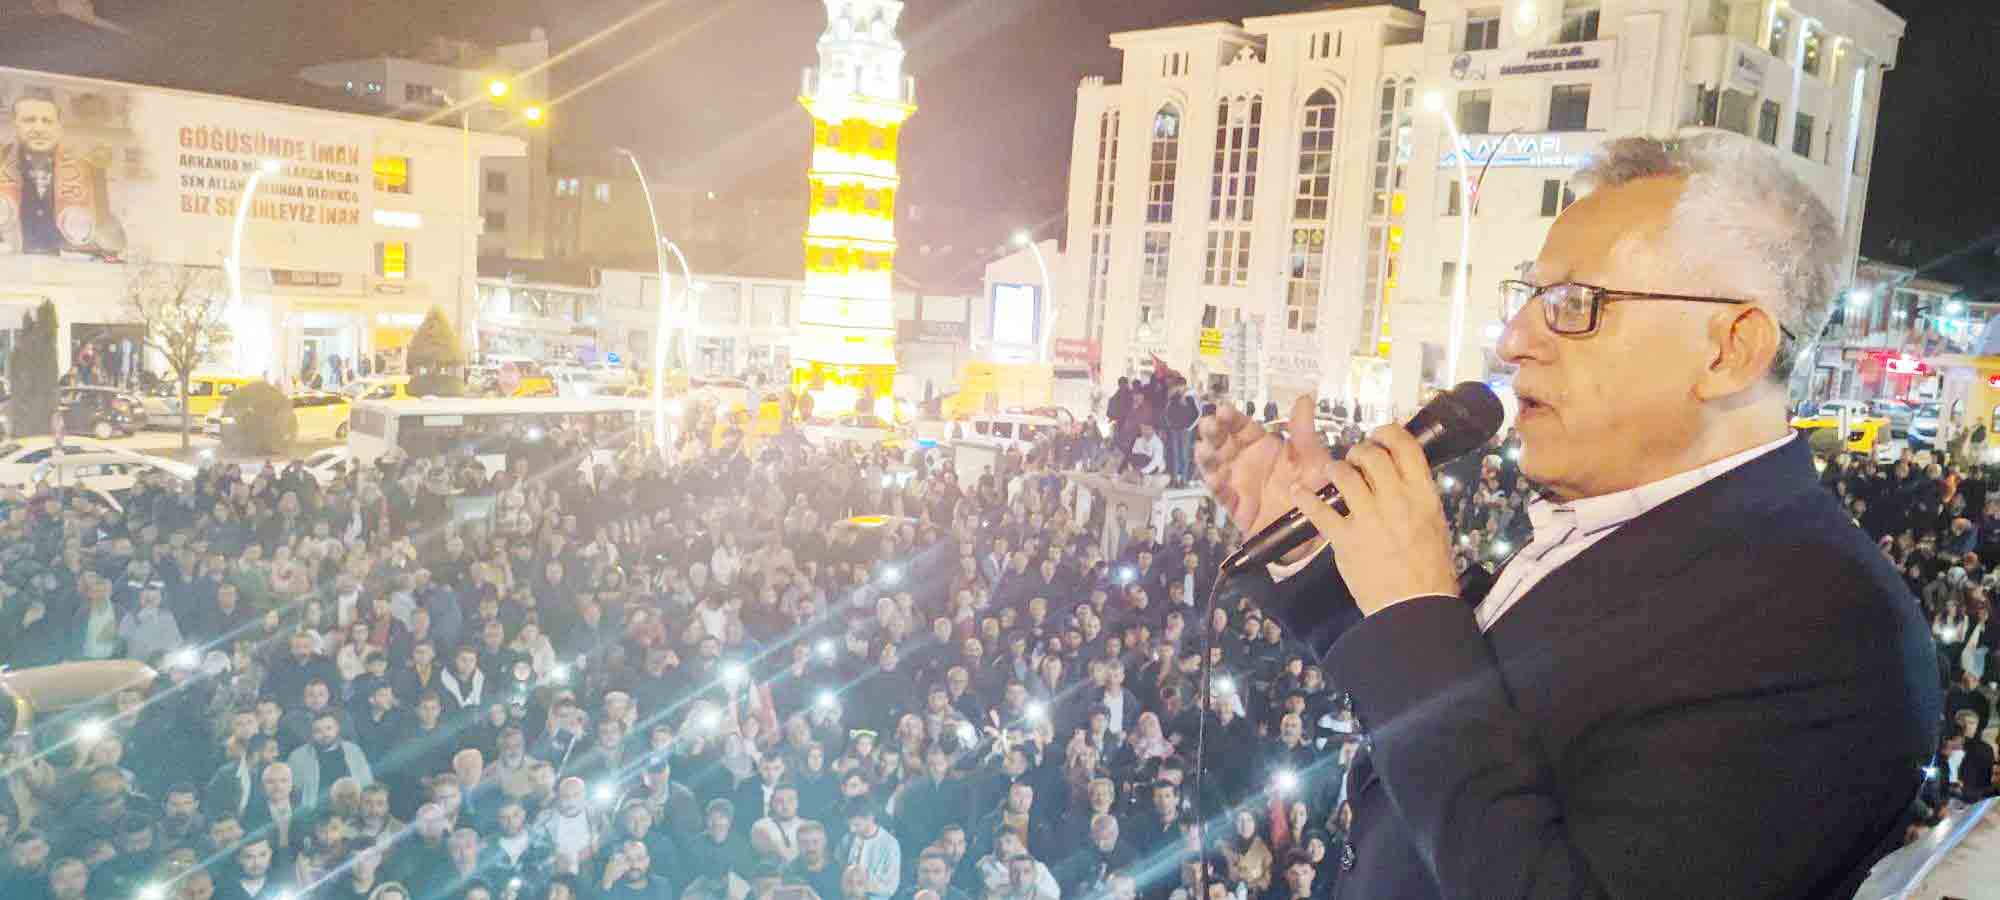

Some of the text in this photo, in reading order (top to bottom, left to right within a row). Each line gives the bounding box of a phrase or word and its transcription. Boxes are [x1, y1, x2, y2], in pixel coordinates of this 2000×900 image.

[179, 154, 238, 171] ARKANDA
[180, 175, 205, 189] SEN
[180, 193, 210, 216] BİZ
